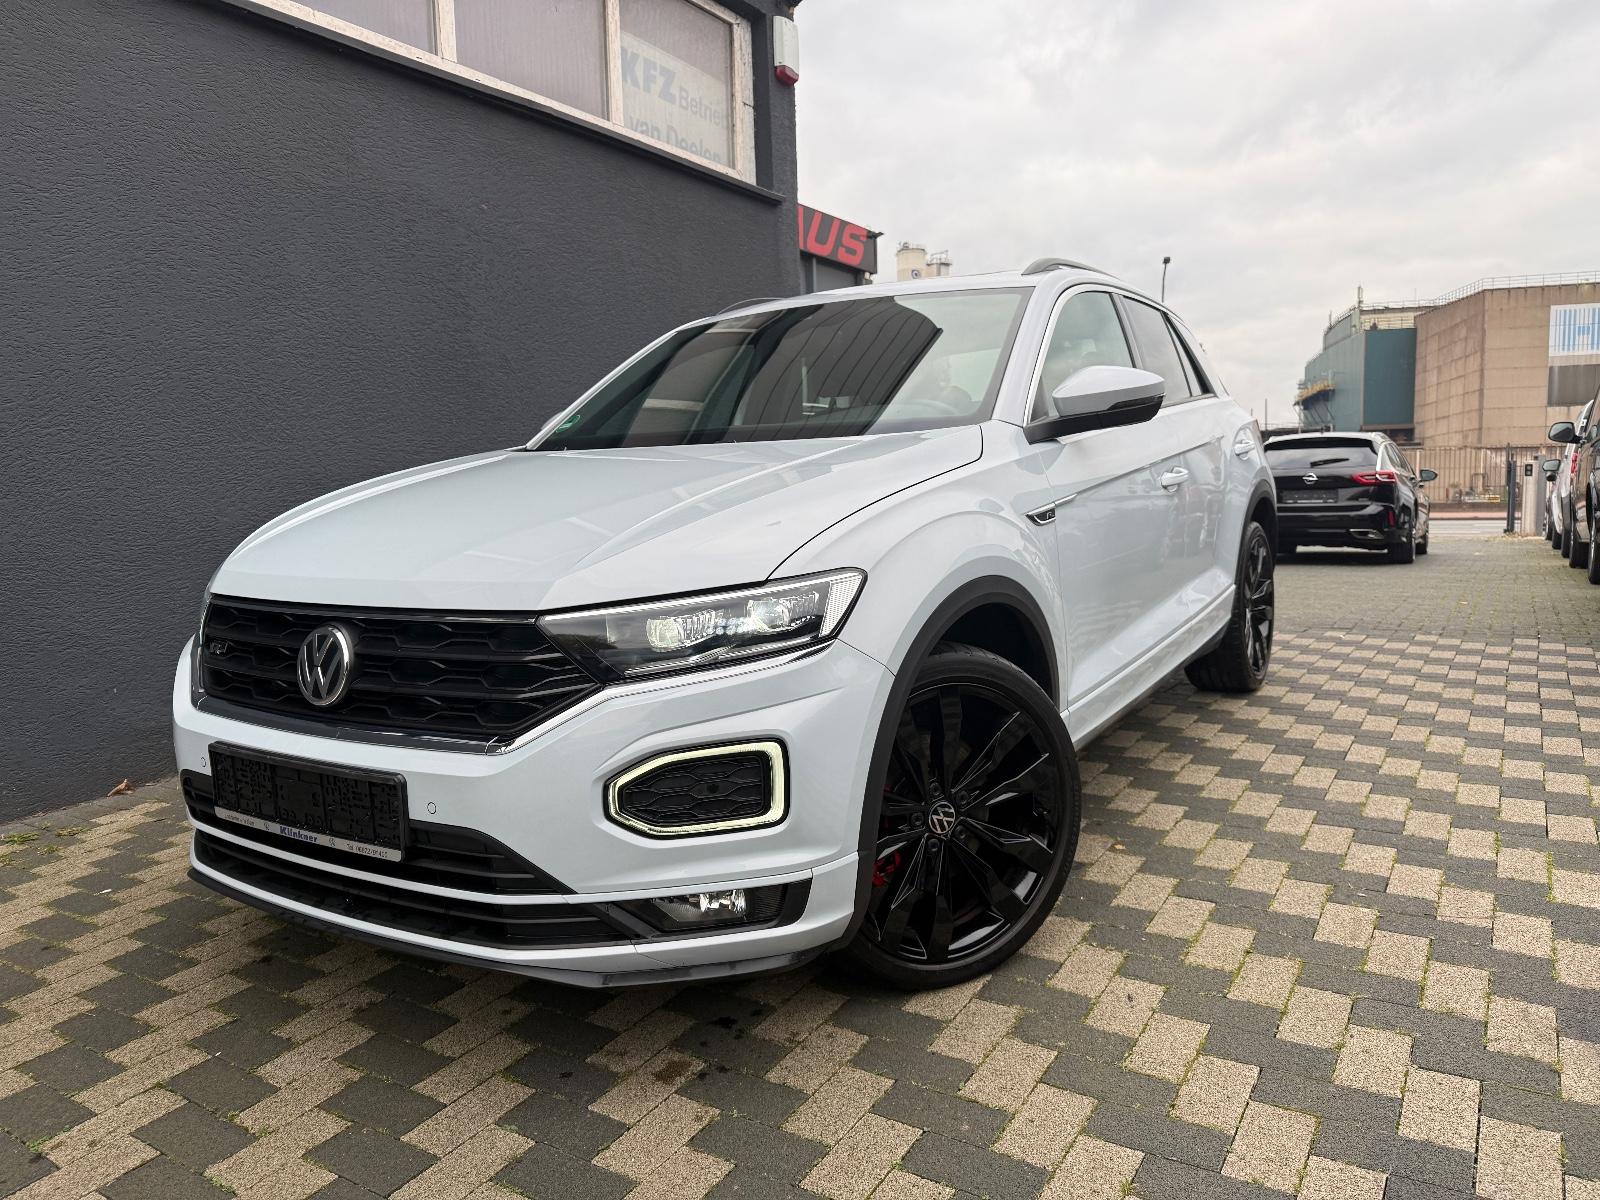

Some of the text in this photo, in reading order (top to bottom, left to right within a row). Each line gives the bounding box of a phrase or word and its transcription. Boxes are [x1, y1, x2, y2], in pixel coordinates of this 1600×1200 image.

[621, 47, 678, 105] KFZ
[629, 116, 661, 141] van
[280, 825, 317, 842] Klinkner
